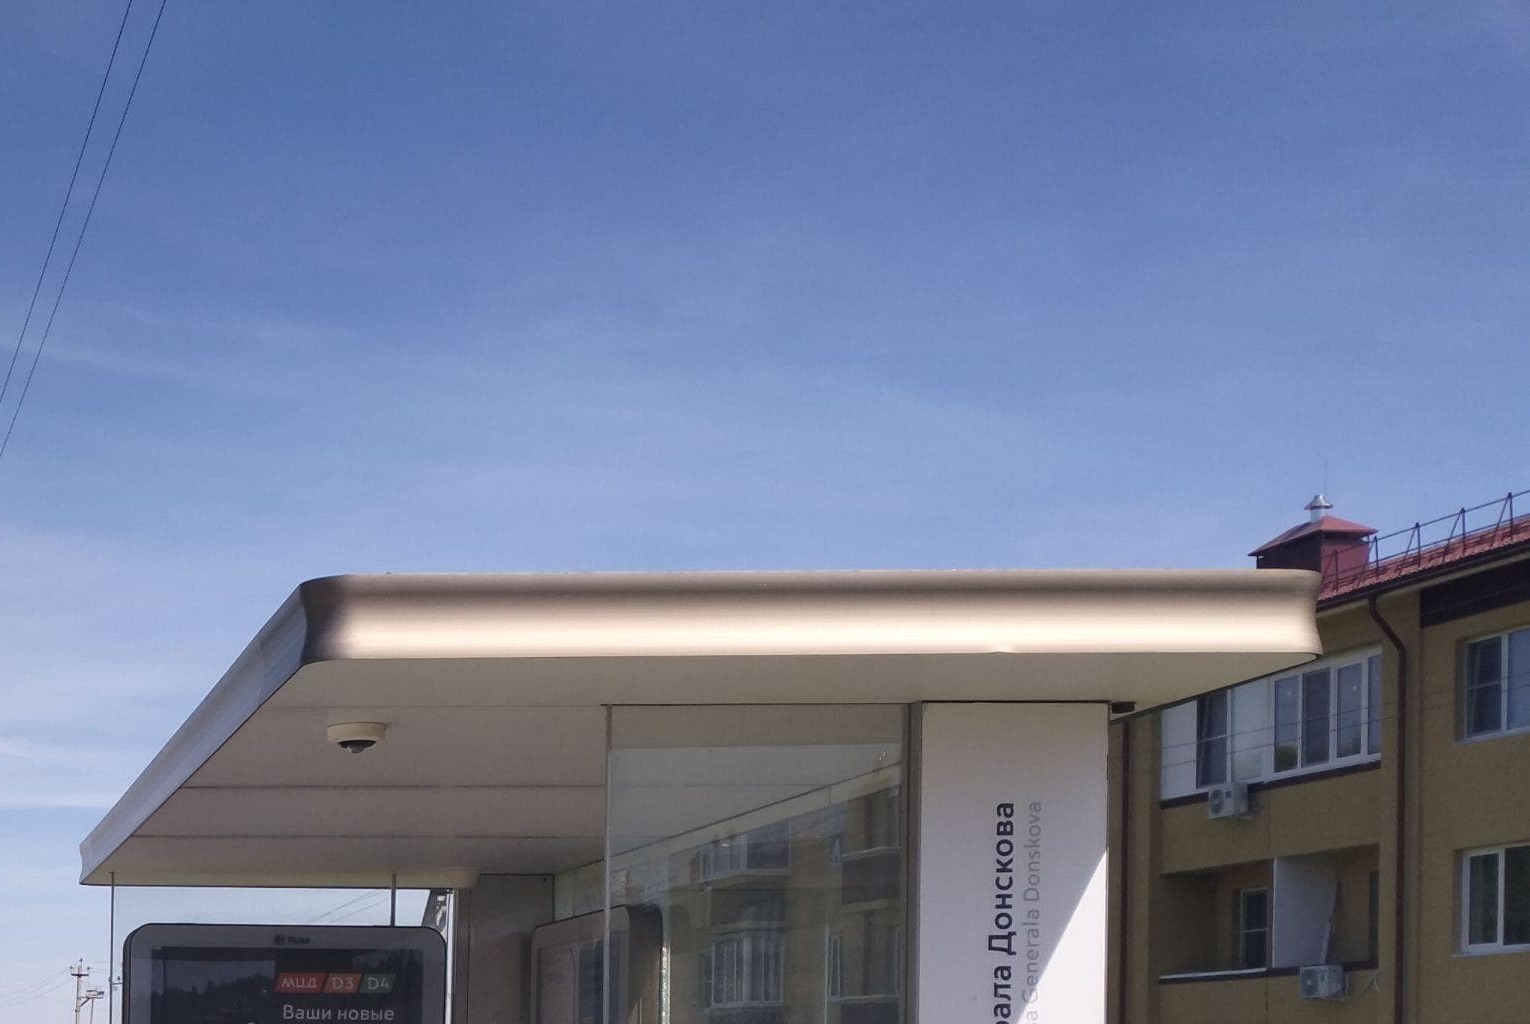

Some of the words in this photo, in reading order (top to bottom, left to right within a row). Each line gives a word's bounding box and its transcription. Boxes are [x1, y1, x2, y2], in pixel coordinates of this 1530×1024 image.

[988, 802, 1017, 956] Донскова
[1023, 801, 1043, 901] Donskova
[281, 977, 318, 989] МЦД
[332, 978, 355, 990] D3
[367, 978, 391, 990] D4
[1022, 908, 1041, 1003] Generala
[282, 1004, 332, 1020] Ваши
[337, 1009, 395, 1021] новые
